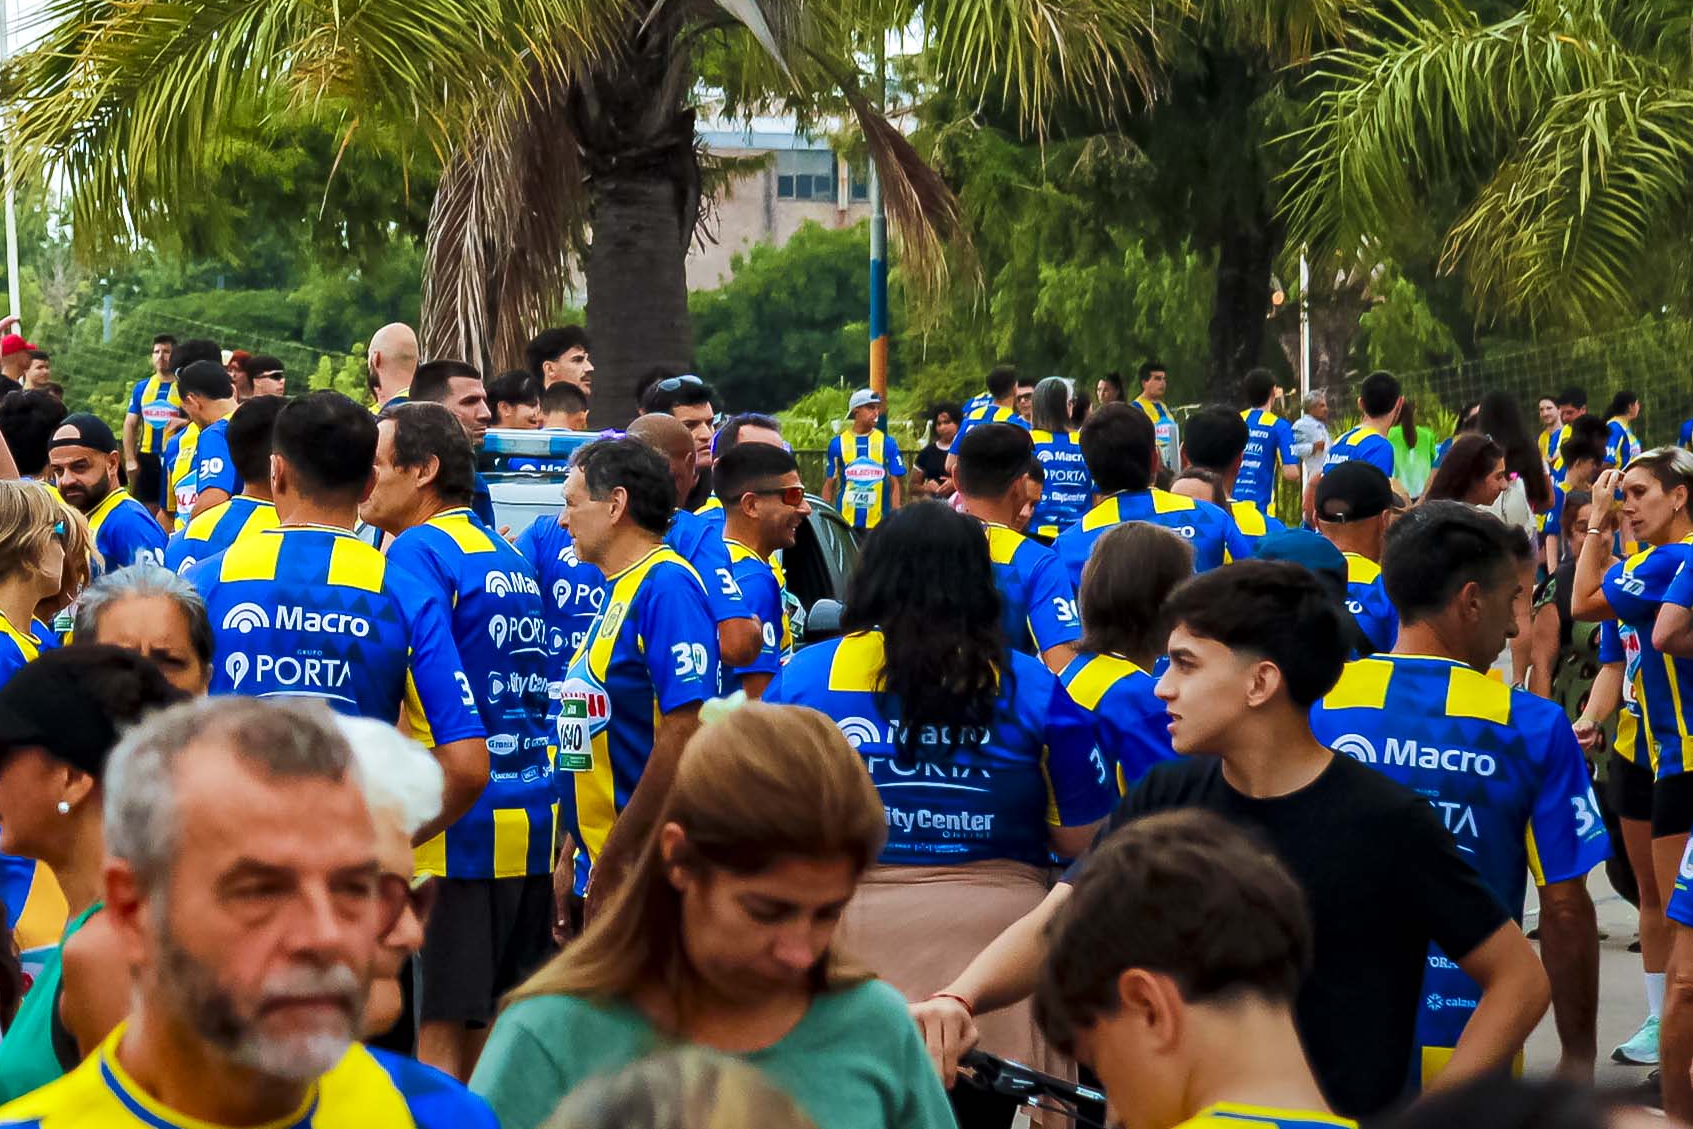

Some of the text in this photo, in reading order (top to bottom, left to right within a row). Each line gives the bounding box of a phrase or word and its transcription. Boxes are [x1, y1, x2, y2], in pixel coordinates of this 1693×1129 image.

[715, 568, 742, 596] 3
[275, 605, 370, 637] Macro
[762, 622, 776, 647] 0
[257, 655, 351, 688] PORTA
[671, 642, 708, 676] 30
[454, 670, 475, 706] 3
[1383, 737, 1496, 776] Macro
[884, 806, 995, 832] ityCenter
